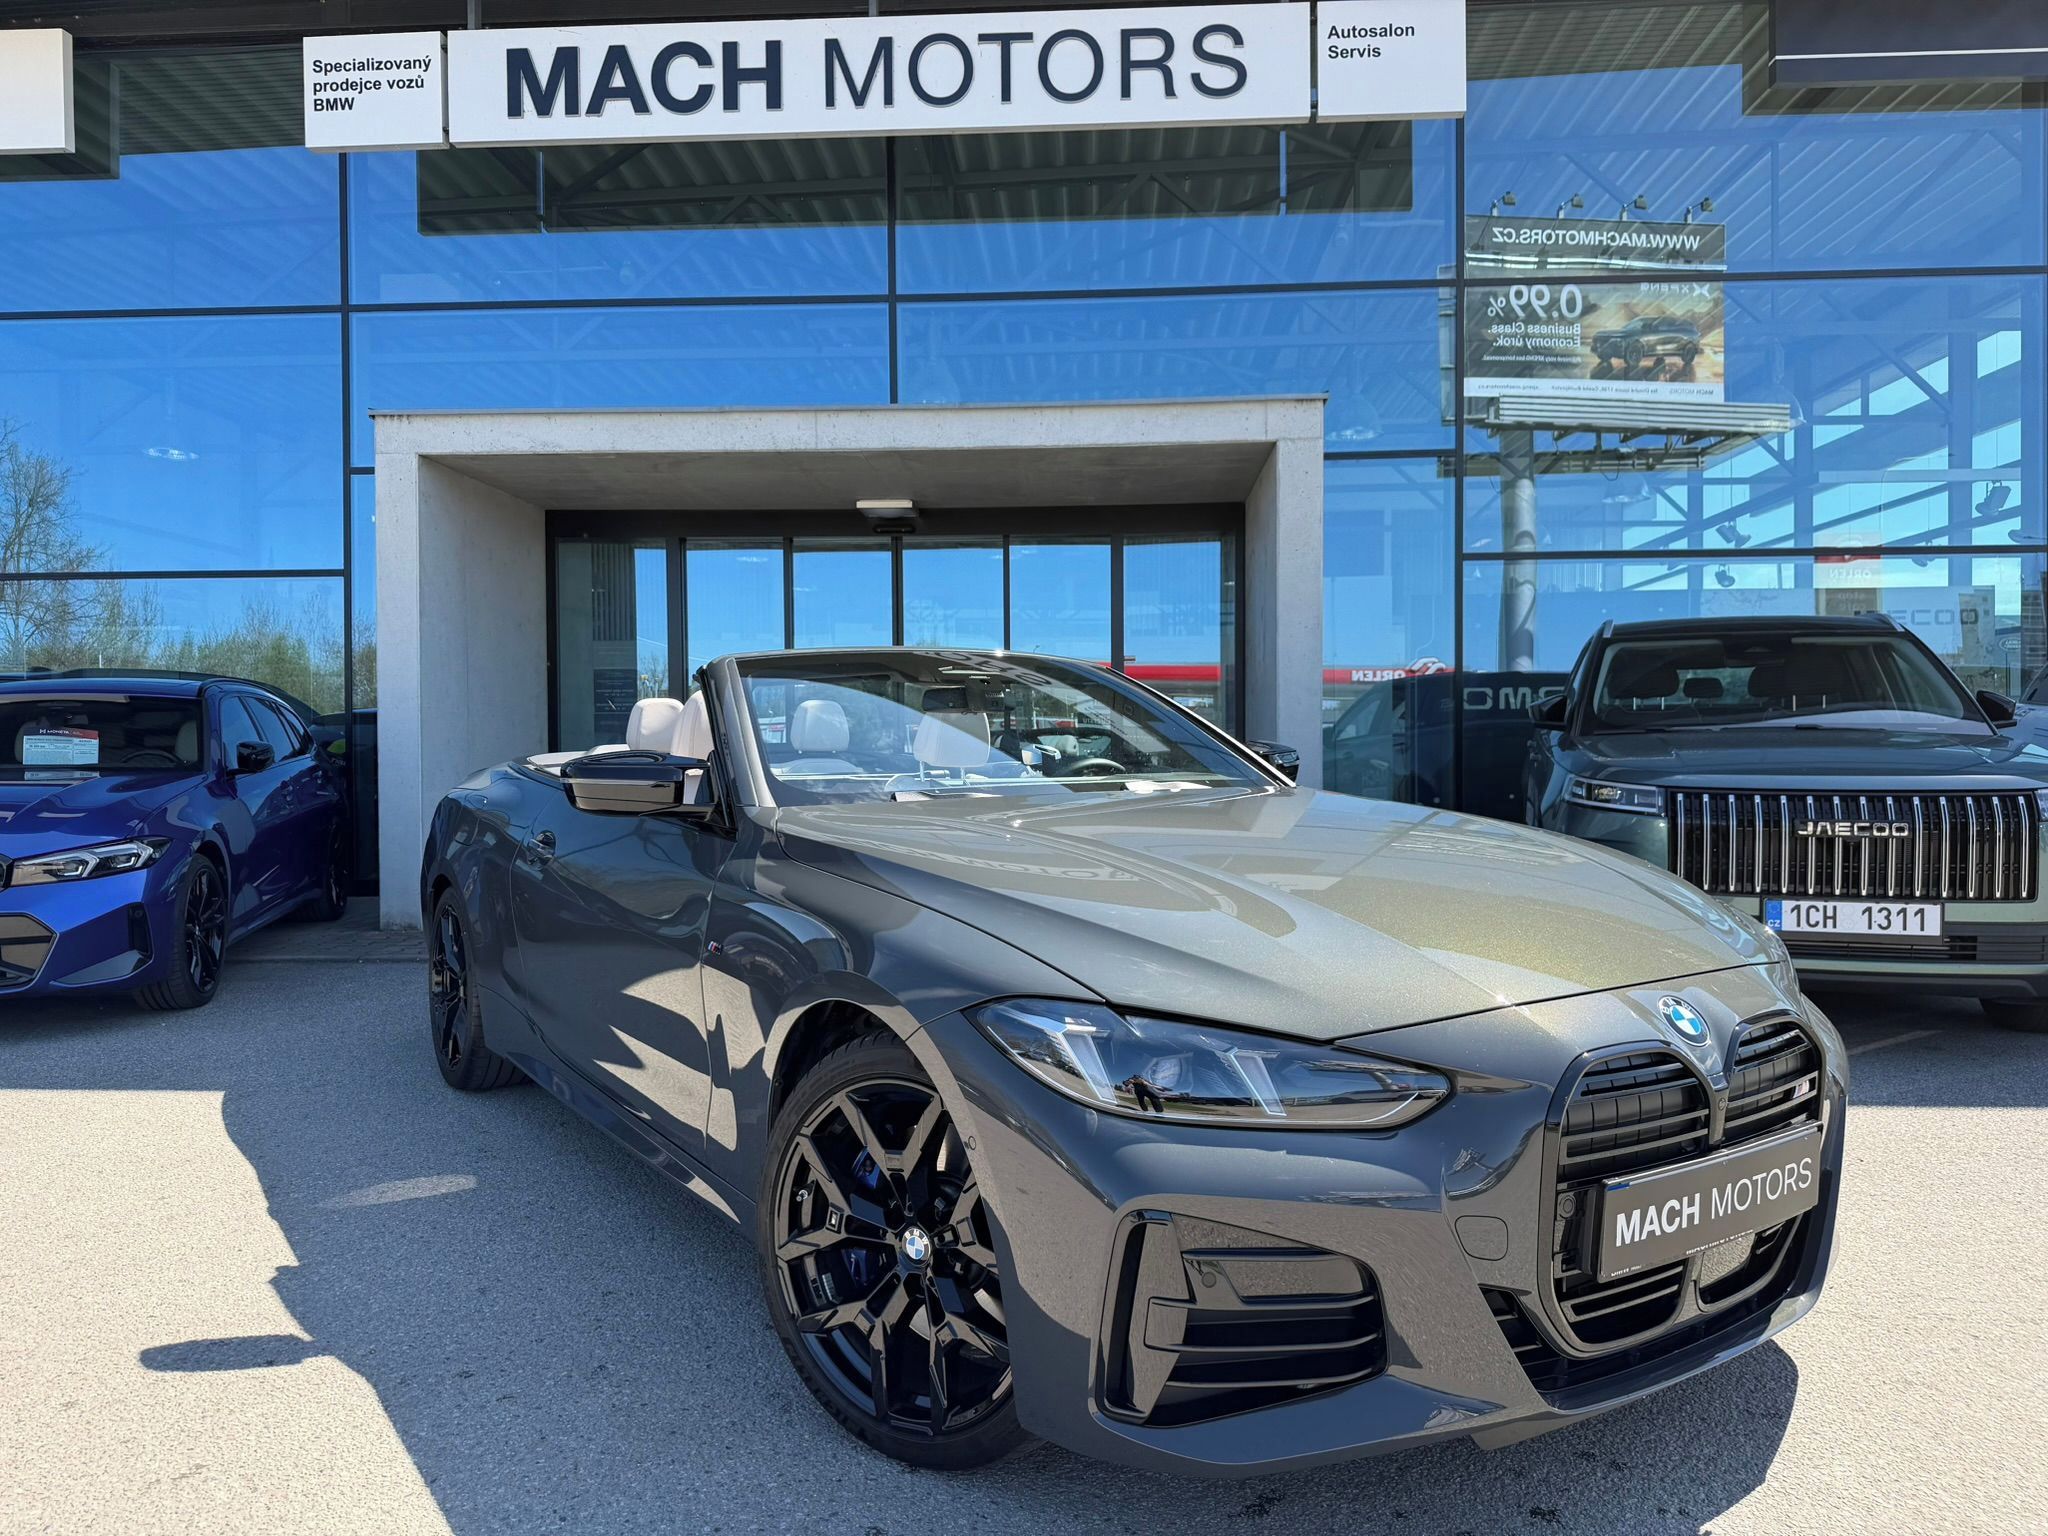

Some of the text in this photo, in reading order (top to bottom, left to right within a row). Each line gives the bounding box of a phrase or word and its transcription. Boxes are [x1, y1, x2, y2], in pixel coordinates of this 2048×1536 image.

[1327, 24, 1415, 40] Autosalon
[1327, 44, 1382, 59] Servis
[312, 55, 432, 75] Specializovaný
[506, 24, 1247, 118] MACH MOTORS
[313, 73, 425, 94] prodejce vozů
[313, 96, 355, 112] BMW
[1797, 821, 1909, 837] JAECOO
[1767, 919, 1781, 928] CZ
[1790, 904, 1925, 932] 1CH 1311
[1616, 1193, 1701, 1248] MACH
[1711, 1157, 1812, 1220] MOTORS
[904, 1229, 929, 1245] BMW
